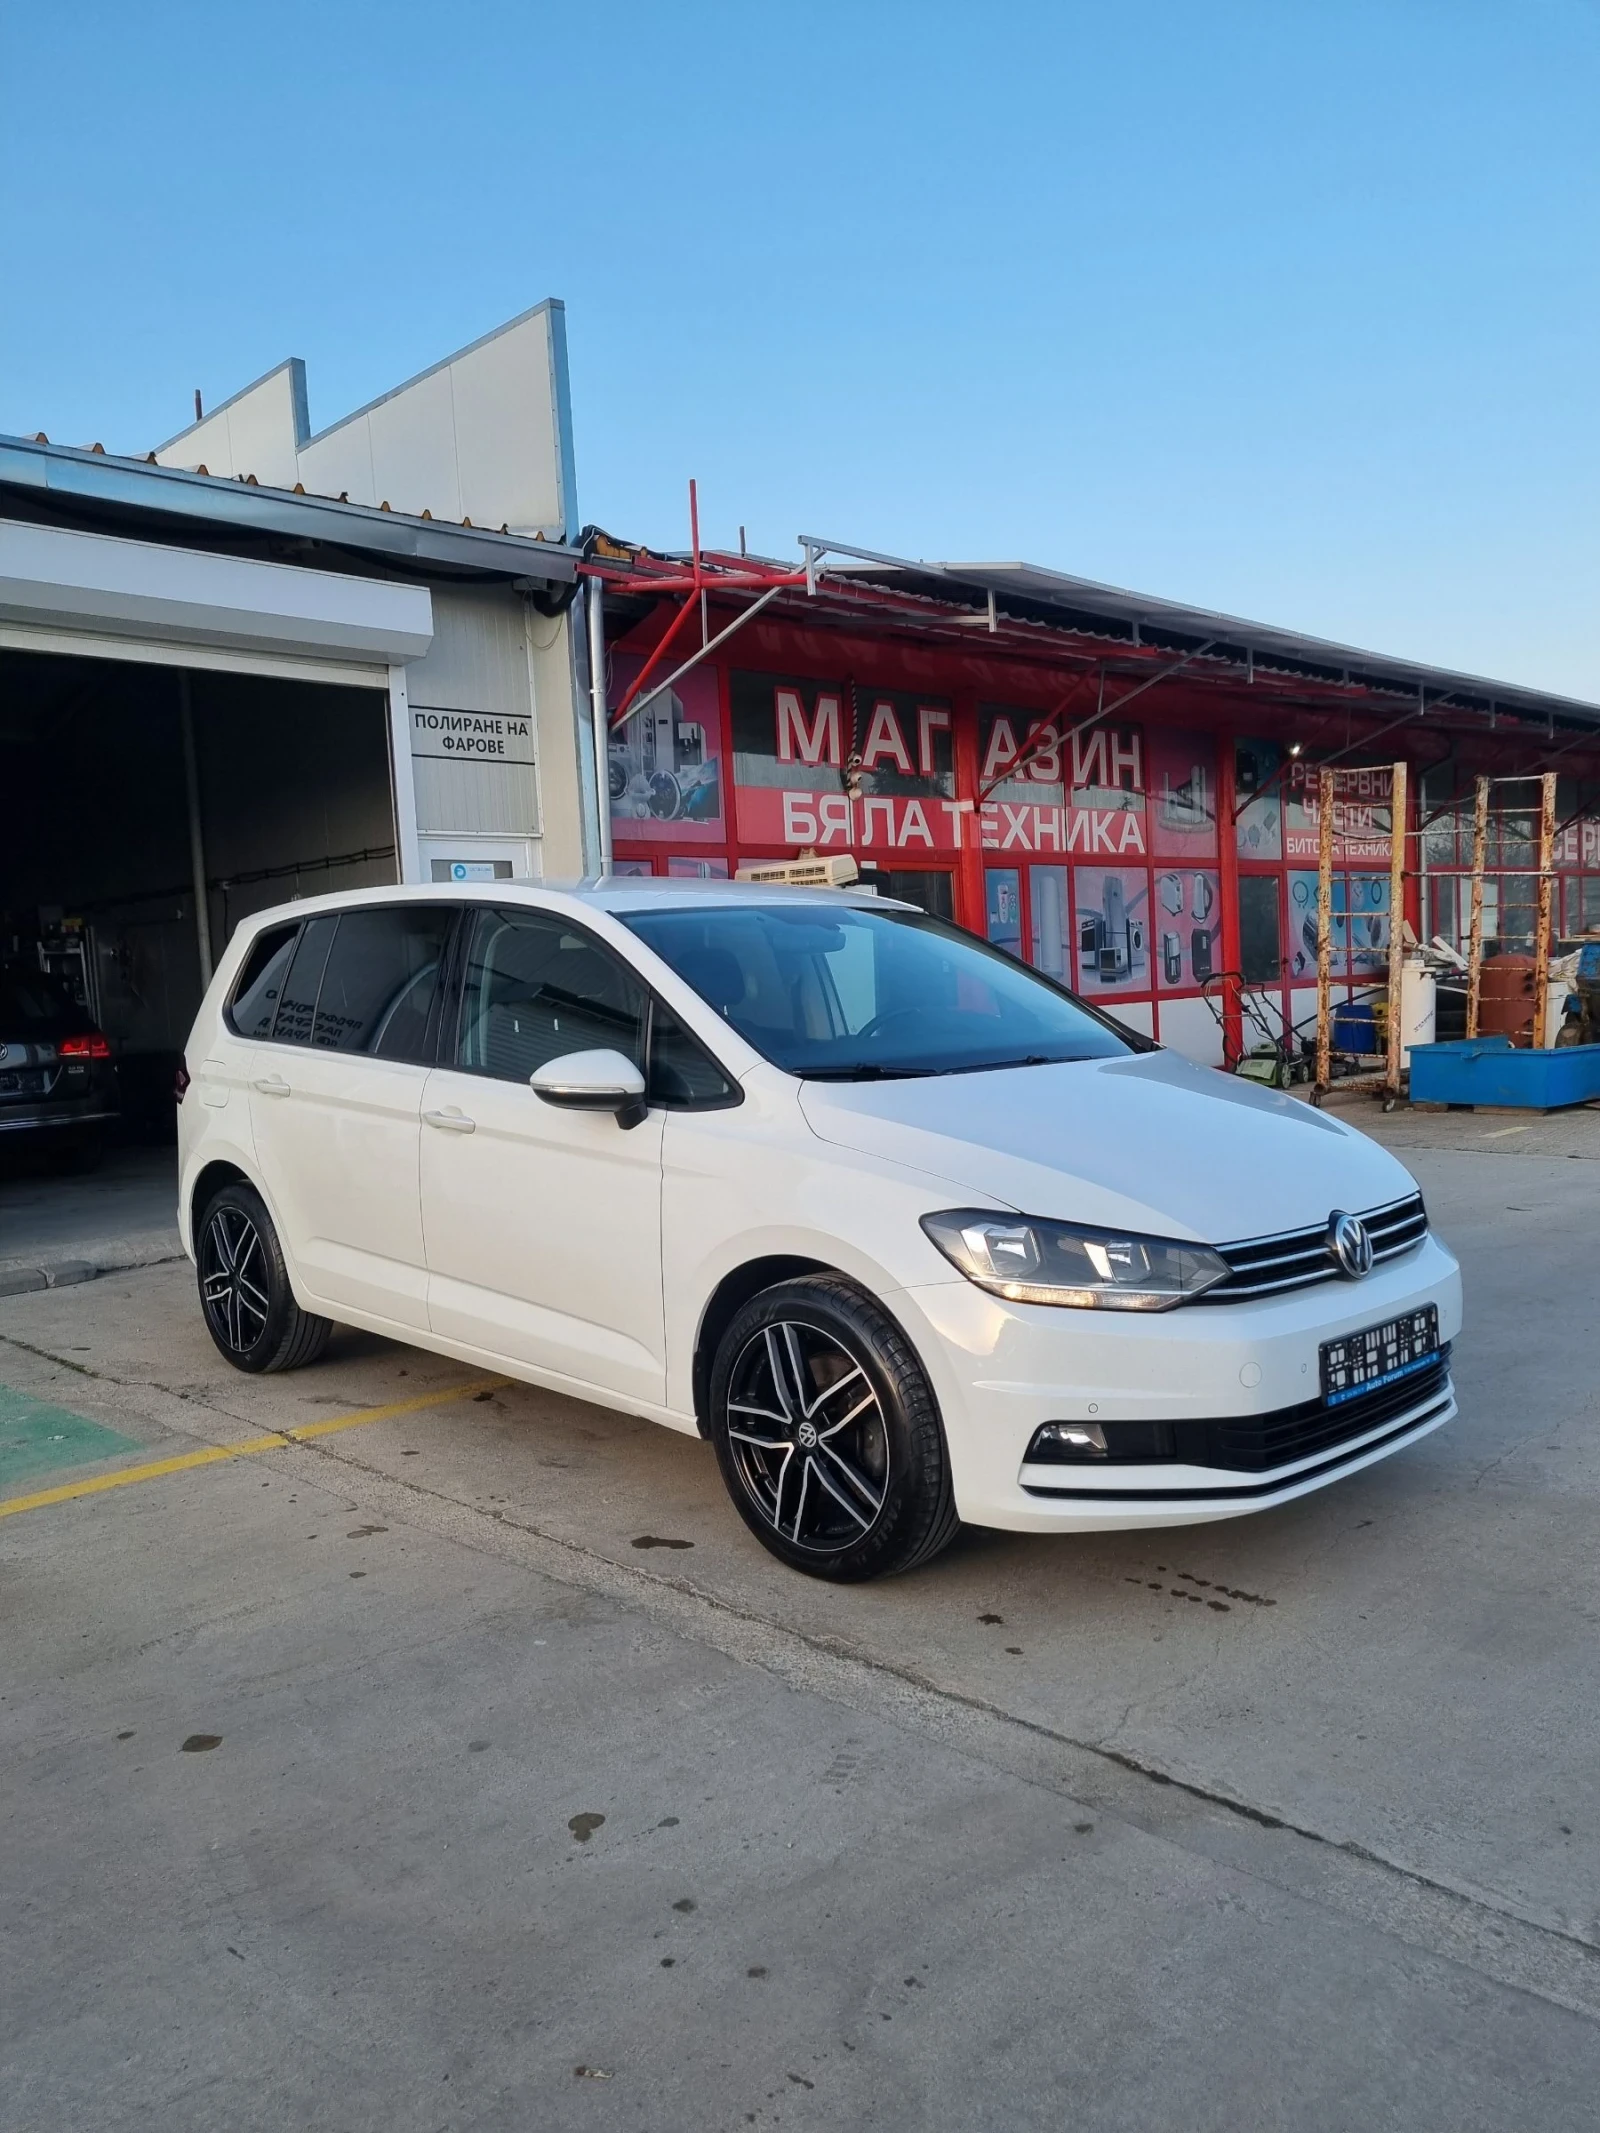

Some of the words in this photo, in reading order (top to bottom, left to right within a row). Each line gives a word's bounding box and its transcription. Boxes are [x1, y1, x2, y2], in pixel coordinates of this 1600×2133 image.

[415, 714, 502, 734] ПОЛИРАНЕ
[507, 721, 528, 736] НА
[442, 736, 504, 754] ФАРОВЕ
[777, 692, 1141, 788] МАГАЗИН
[1291, 763, 1394, 796] РЕЕРВНИ
[783, 792, 934, 848] БЯЛА
[942, 801, 1146, 854] ТЕХНИКА
[1303, 798, 1373, 828] ЧСТИ
[1287, 838, 1340, 854] БИТОА
[1366, 1380, 1382, 1392] Auto
[1383, 1370, 1404, 1384] Forum
